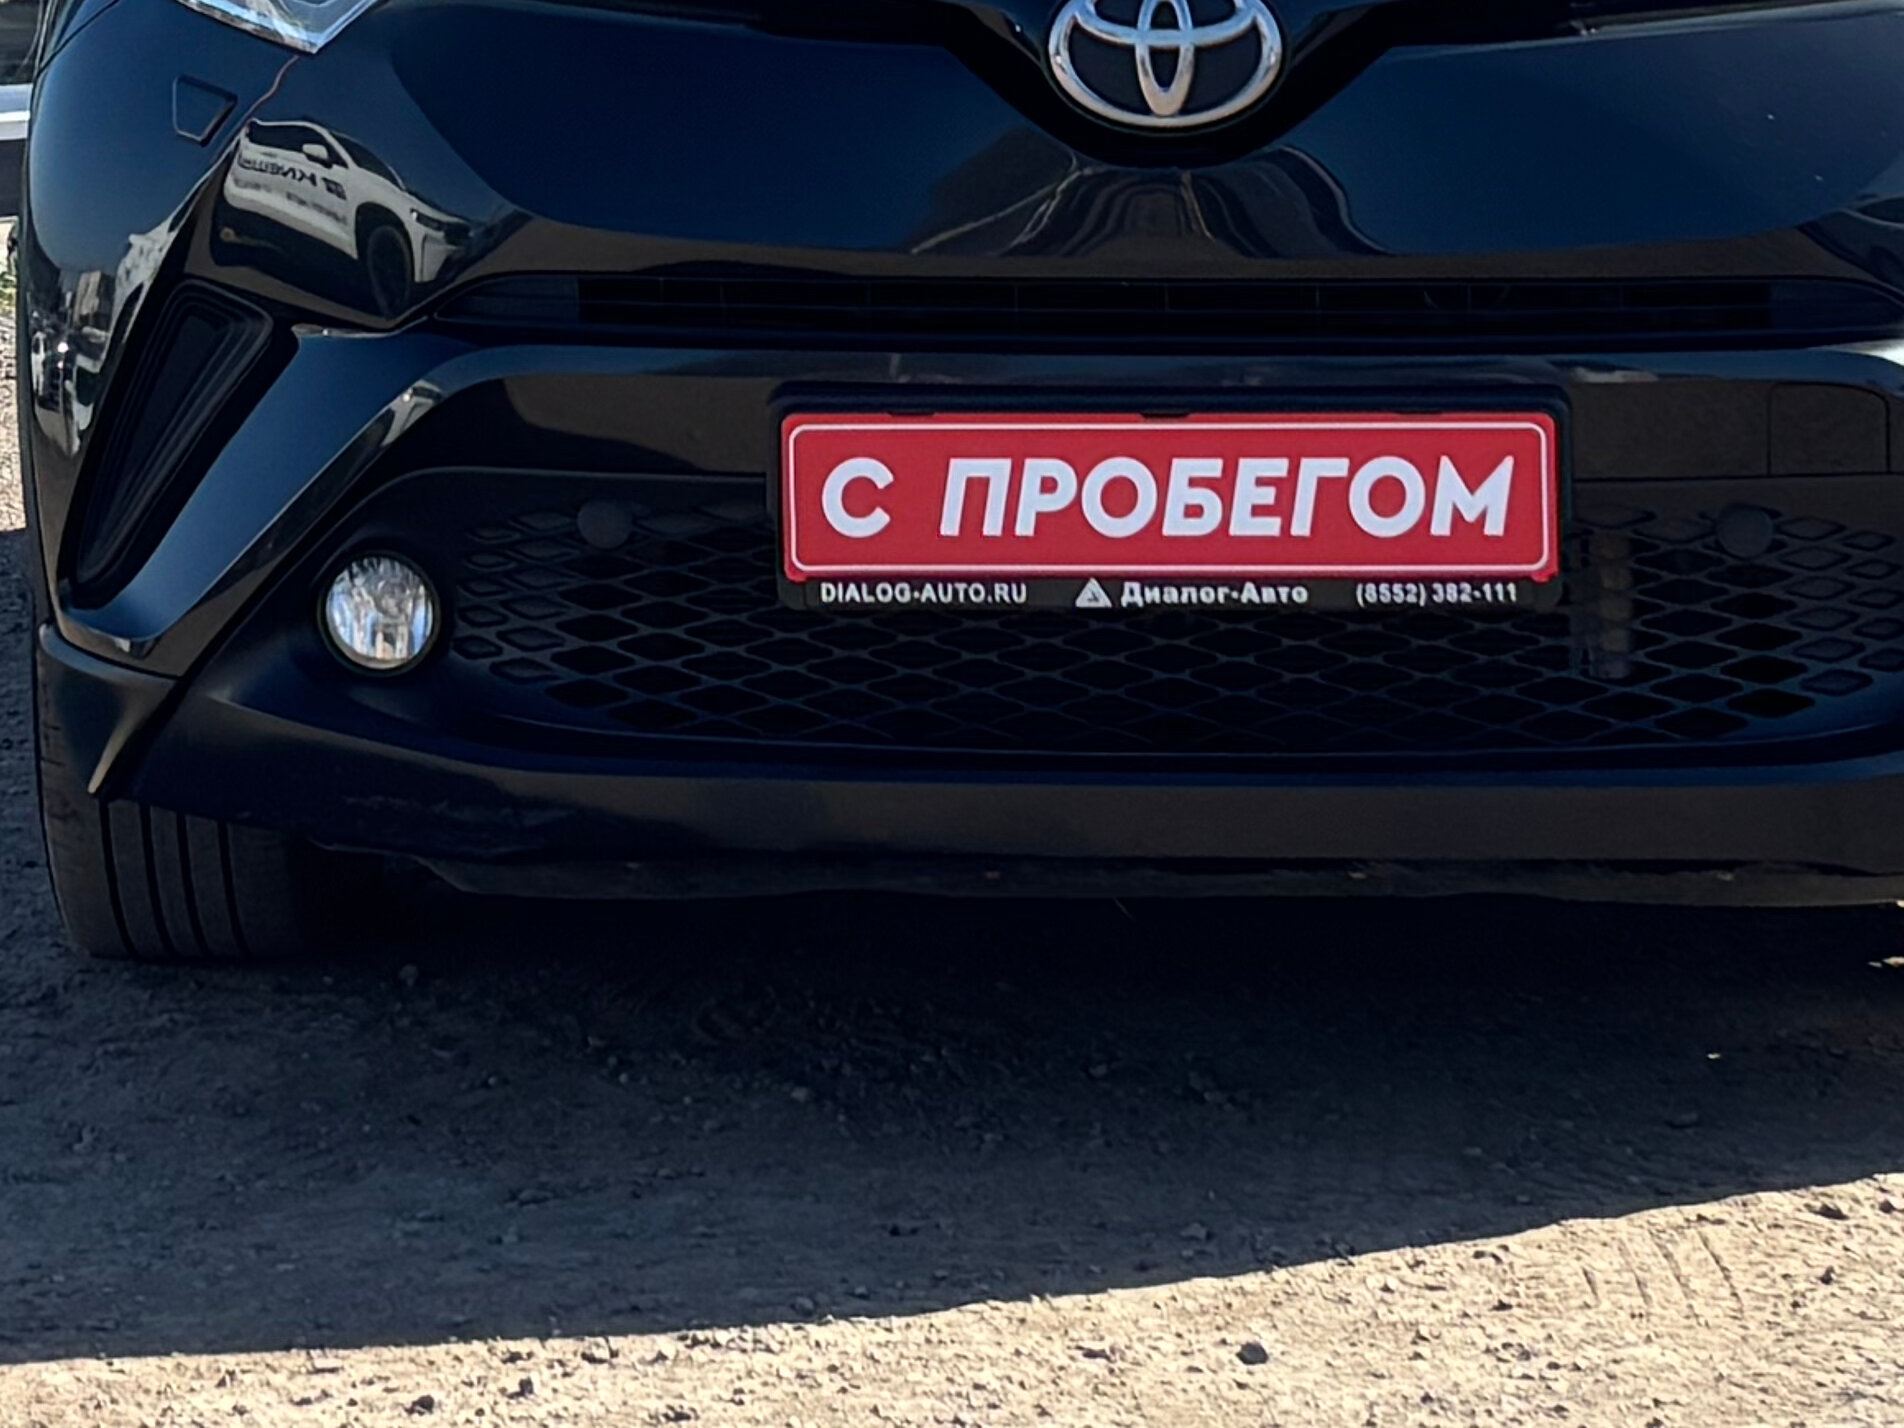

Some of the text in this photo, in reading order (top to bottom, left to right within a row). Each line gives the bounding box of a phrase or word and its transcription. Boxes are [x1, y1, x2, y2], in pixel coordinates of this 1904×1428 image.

[821, 454, 1516, 540] С ПРОБЕГОМ
[819, 582, 1028, 604] DIALOG-AUTO.RU
[1120, 581, 1309, 605] Диалог-Авто
[1355, 582, 1518, 607] (8552) 382-111
